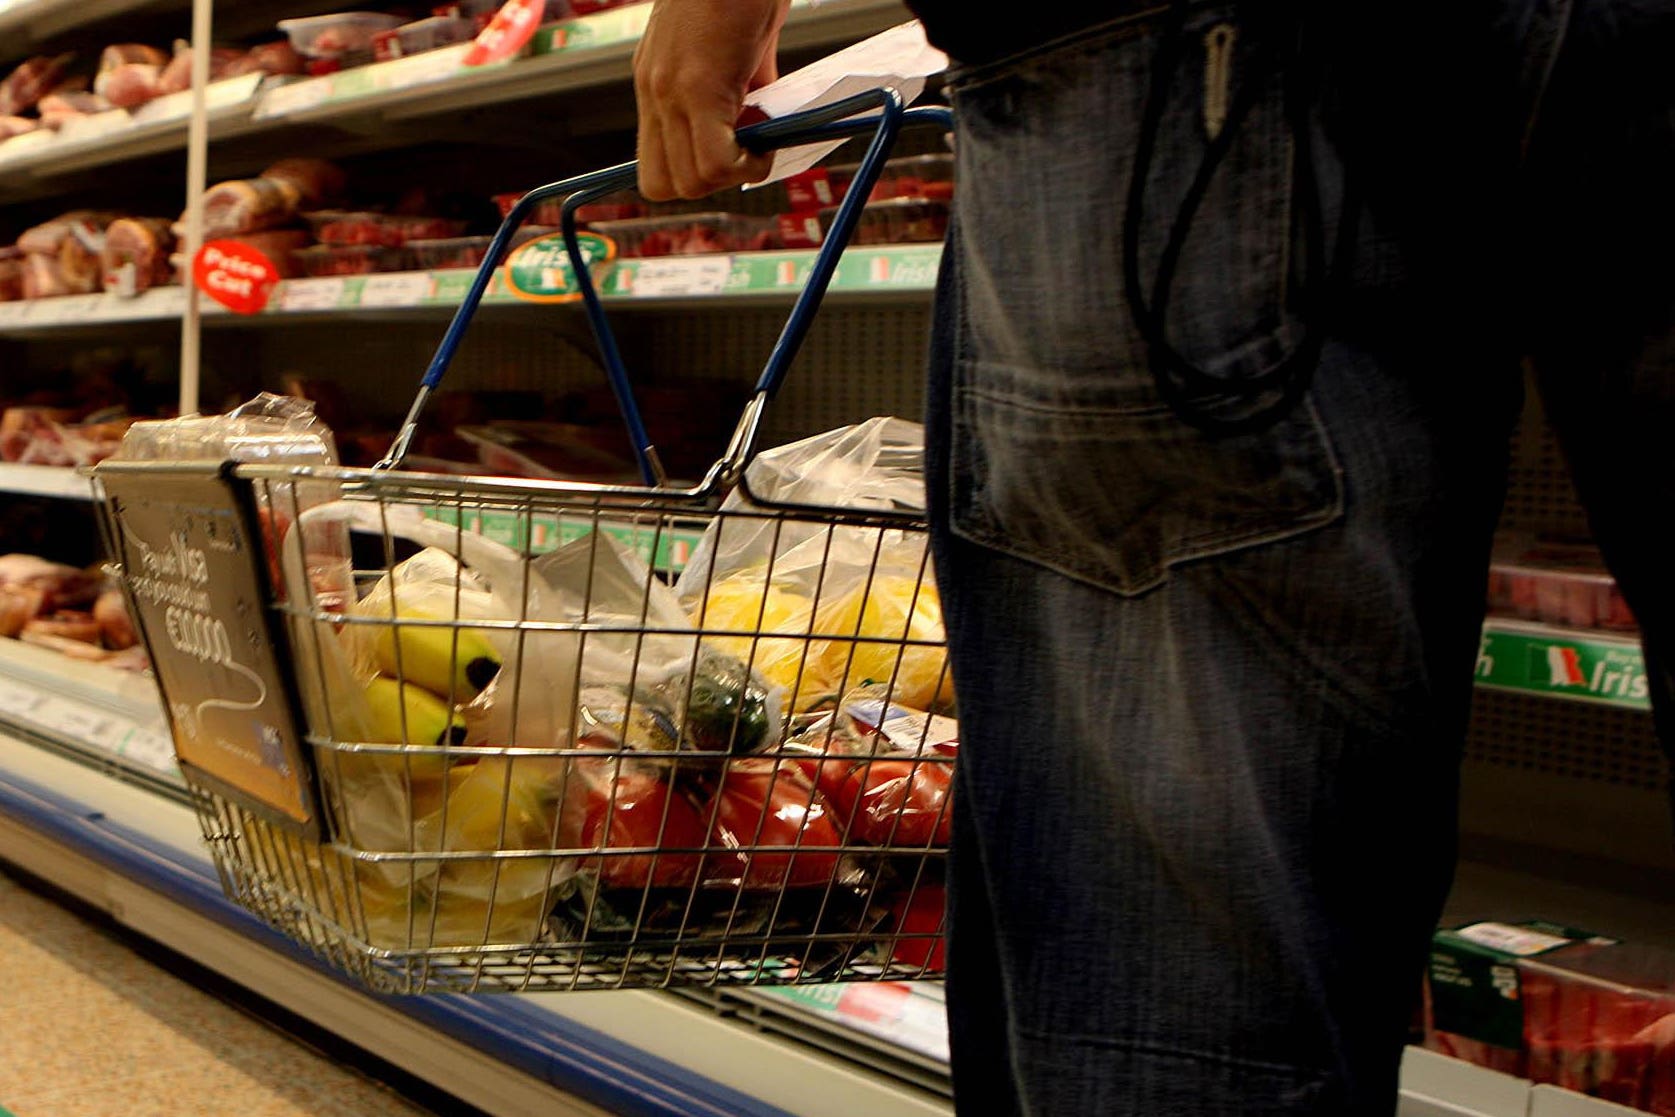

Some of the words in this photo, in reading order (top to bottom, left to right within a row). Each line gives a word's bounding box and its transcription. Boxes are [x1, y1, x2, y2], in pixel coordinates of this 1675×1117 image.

[203, 246, 266, 279] Price
[206, 269, 252, 298] Cut
[1589, 660, 1649, 698] Iris
